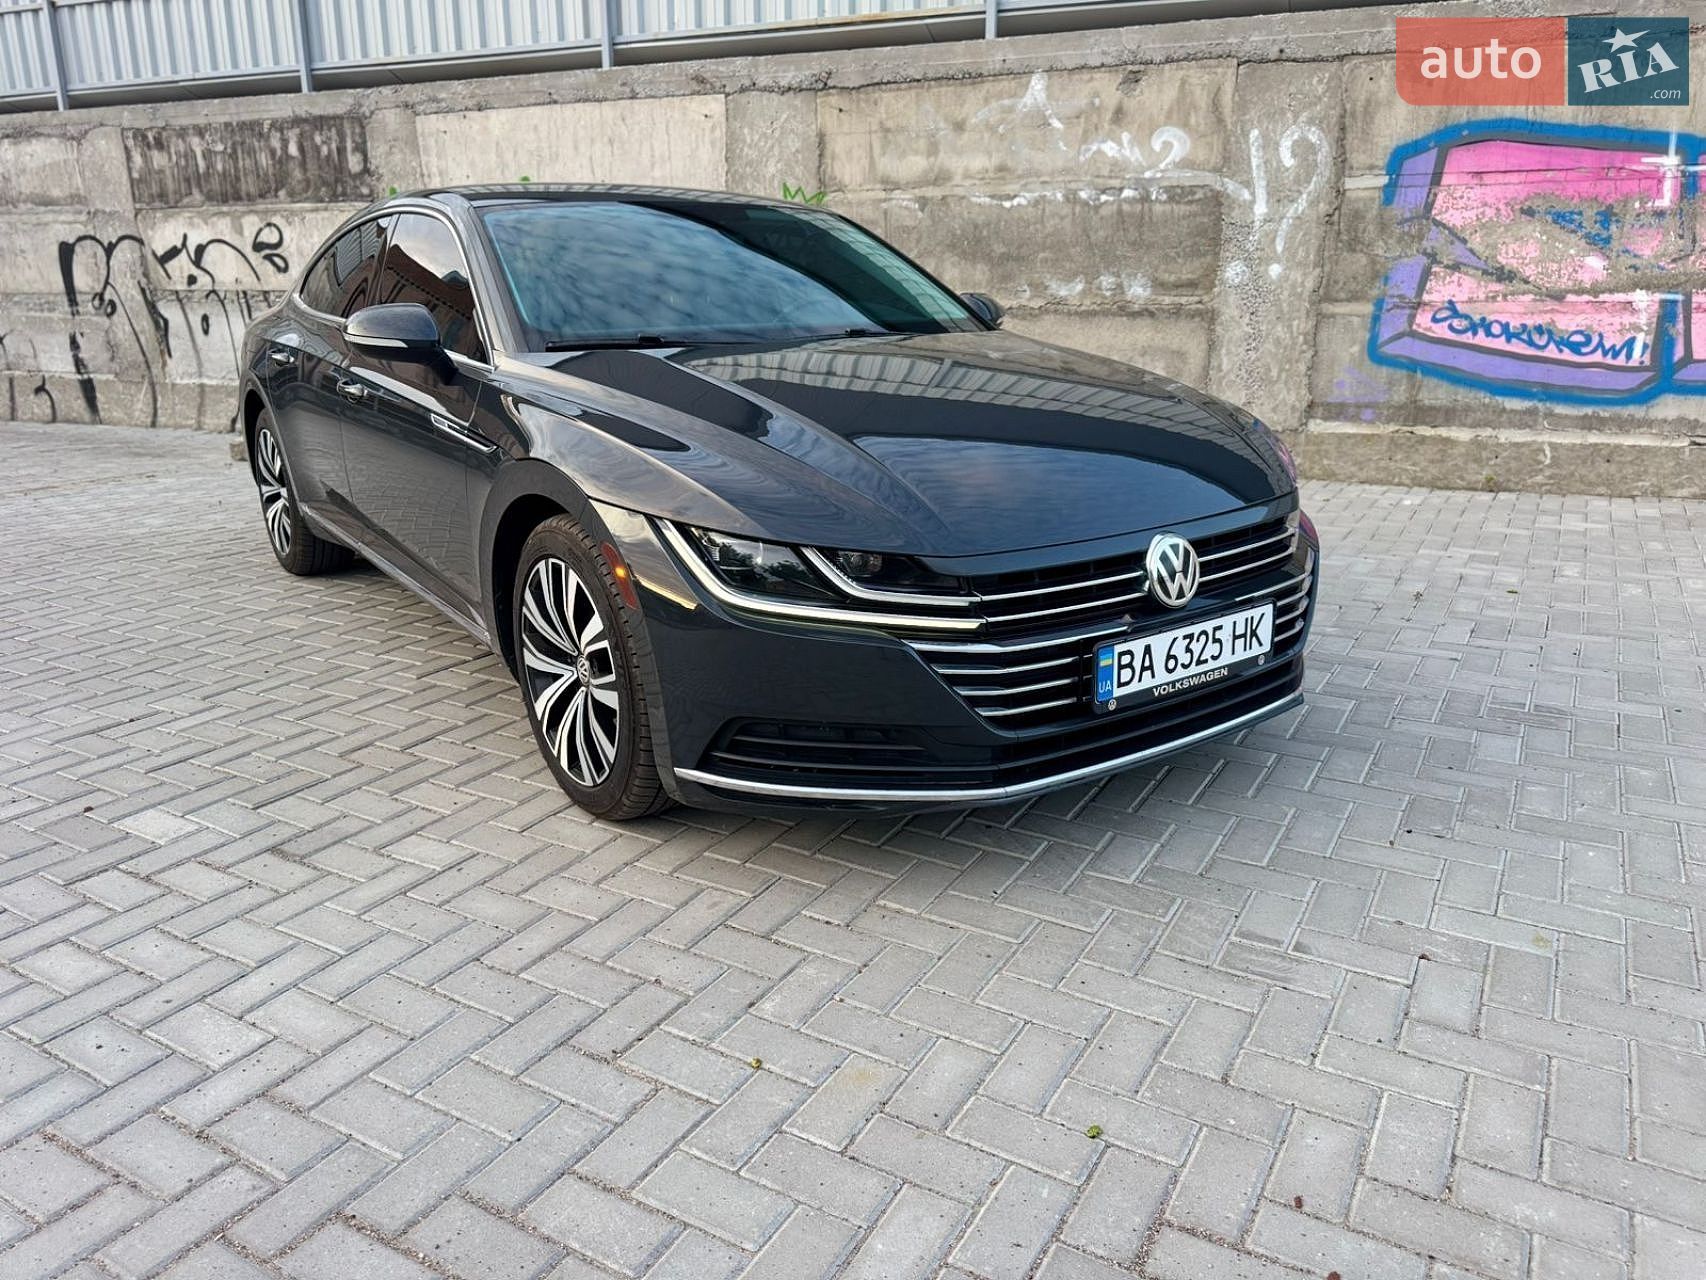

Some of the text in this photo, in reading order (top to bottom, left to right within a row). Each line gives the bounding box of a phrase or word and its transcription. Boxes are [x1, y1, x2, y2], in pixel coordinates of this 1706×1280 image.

[1116, 612, 1266, 689] BA 6325 HK
[1098, 680, 1112, 693] UA
[1152, 666, 1229, 697] VOLKSWAGEN
